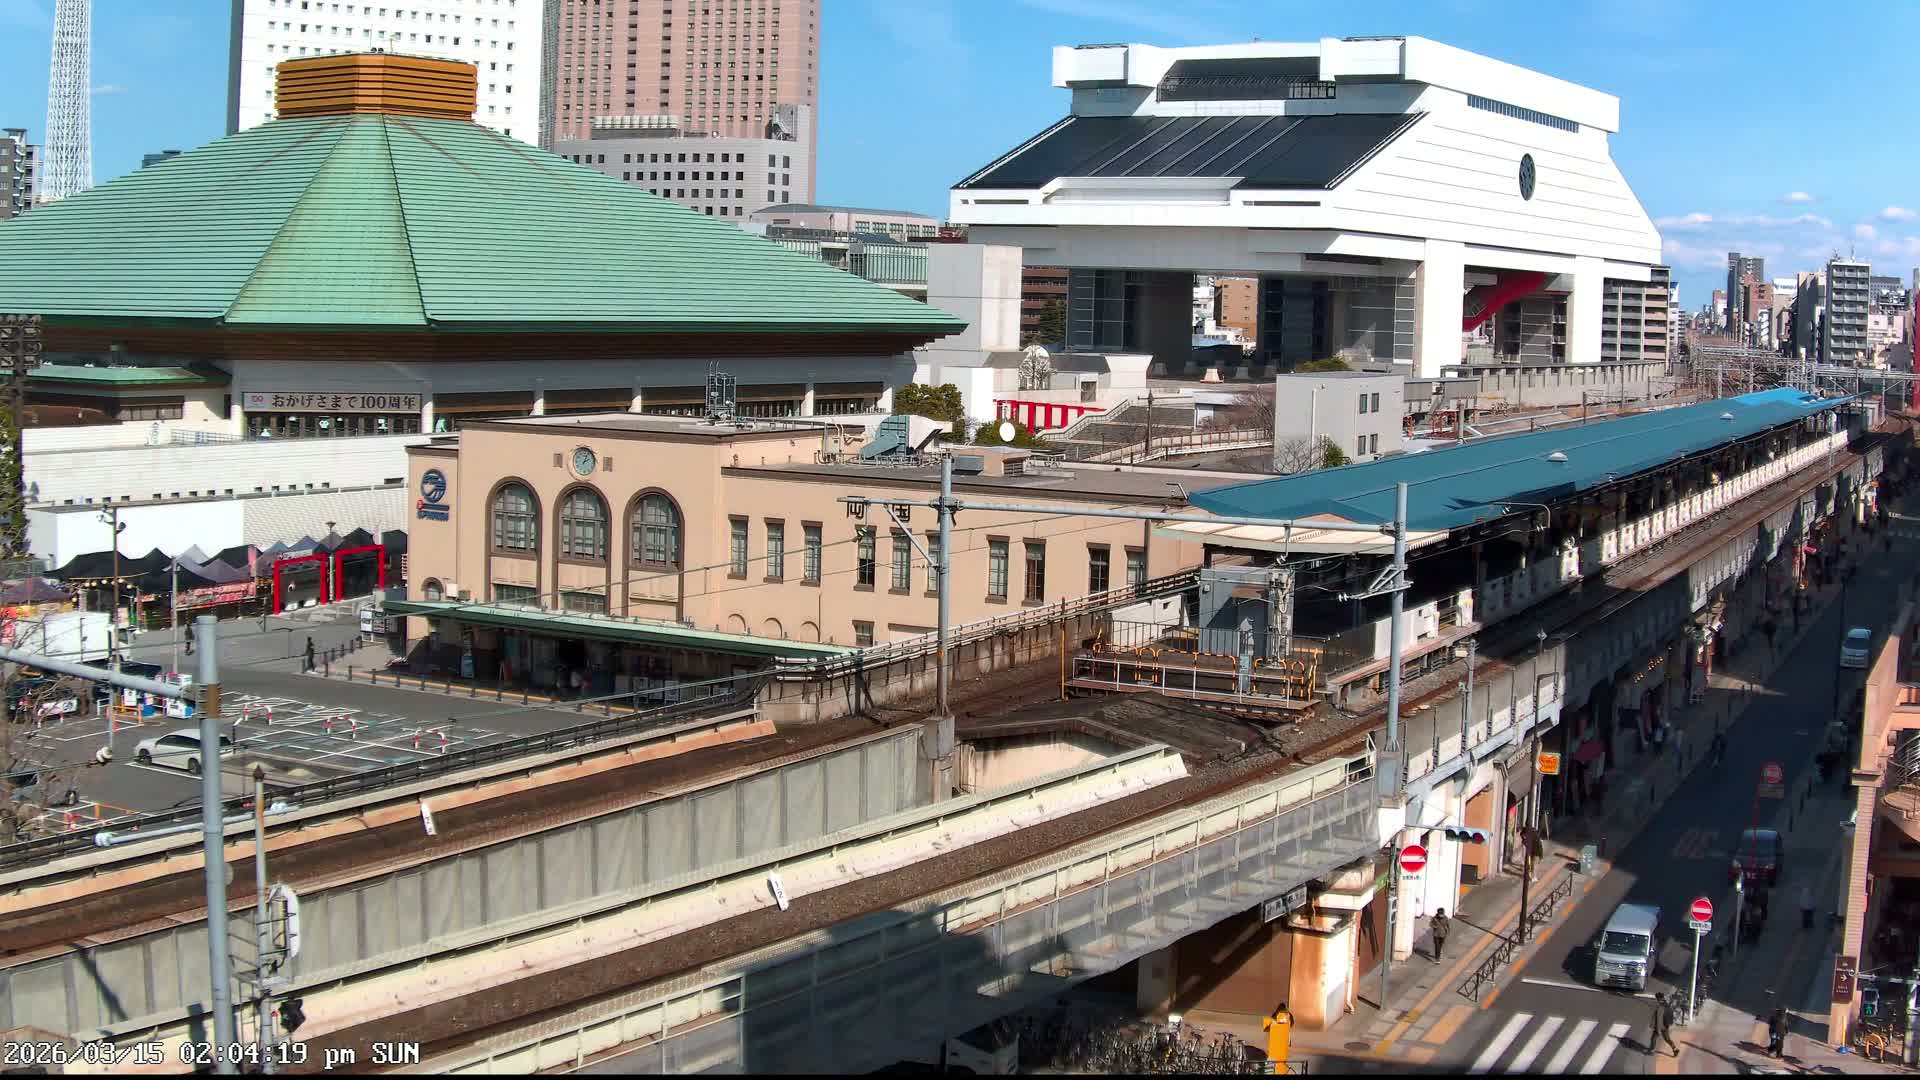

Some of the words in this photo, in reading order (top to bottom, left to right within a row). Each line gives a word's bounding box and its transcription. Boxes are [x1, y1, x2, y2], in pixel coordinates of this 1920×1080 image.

[271, 394, 416, 409] おかげさまで100周年
